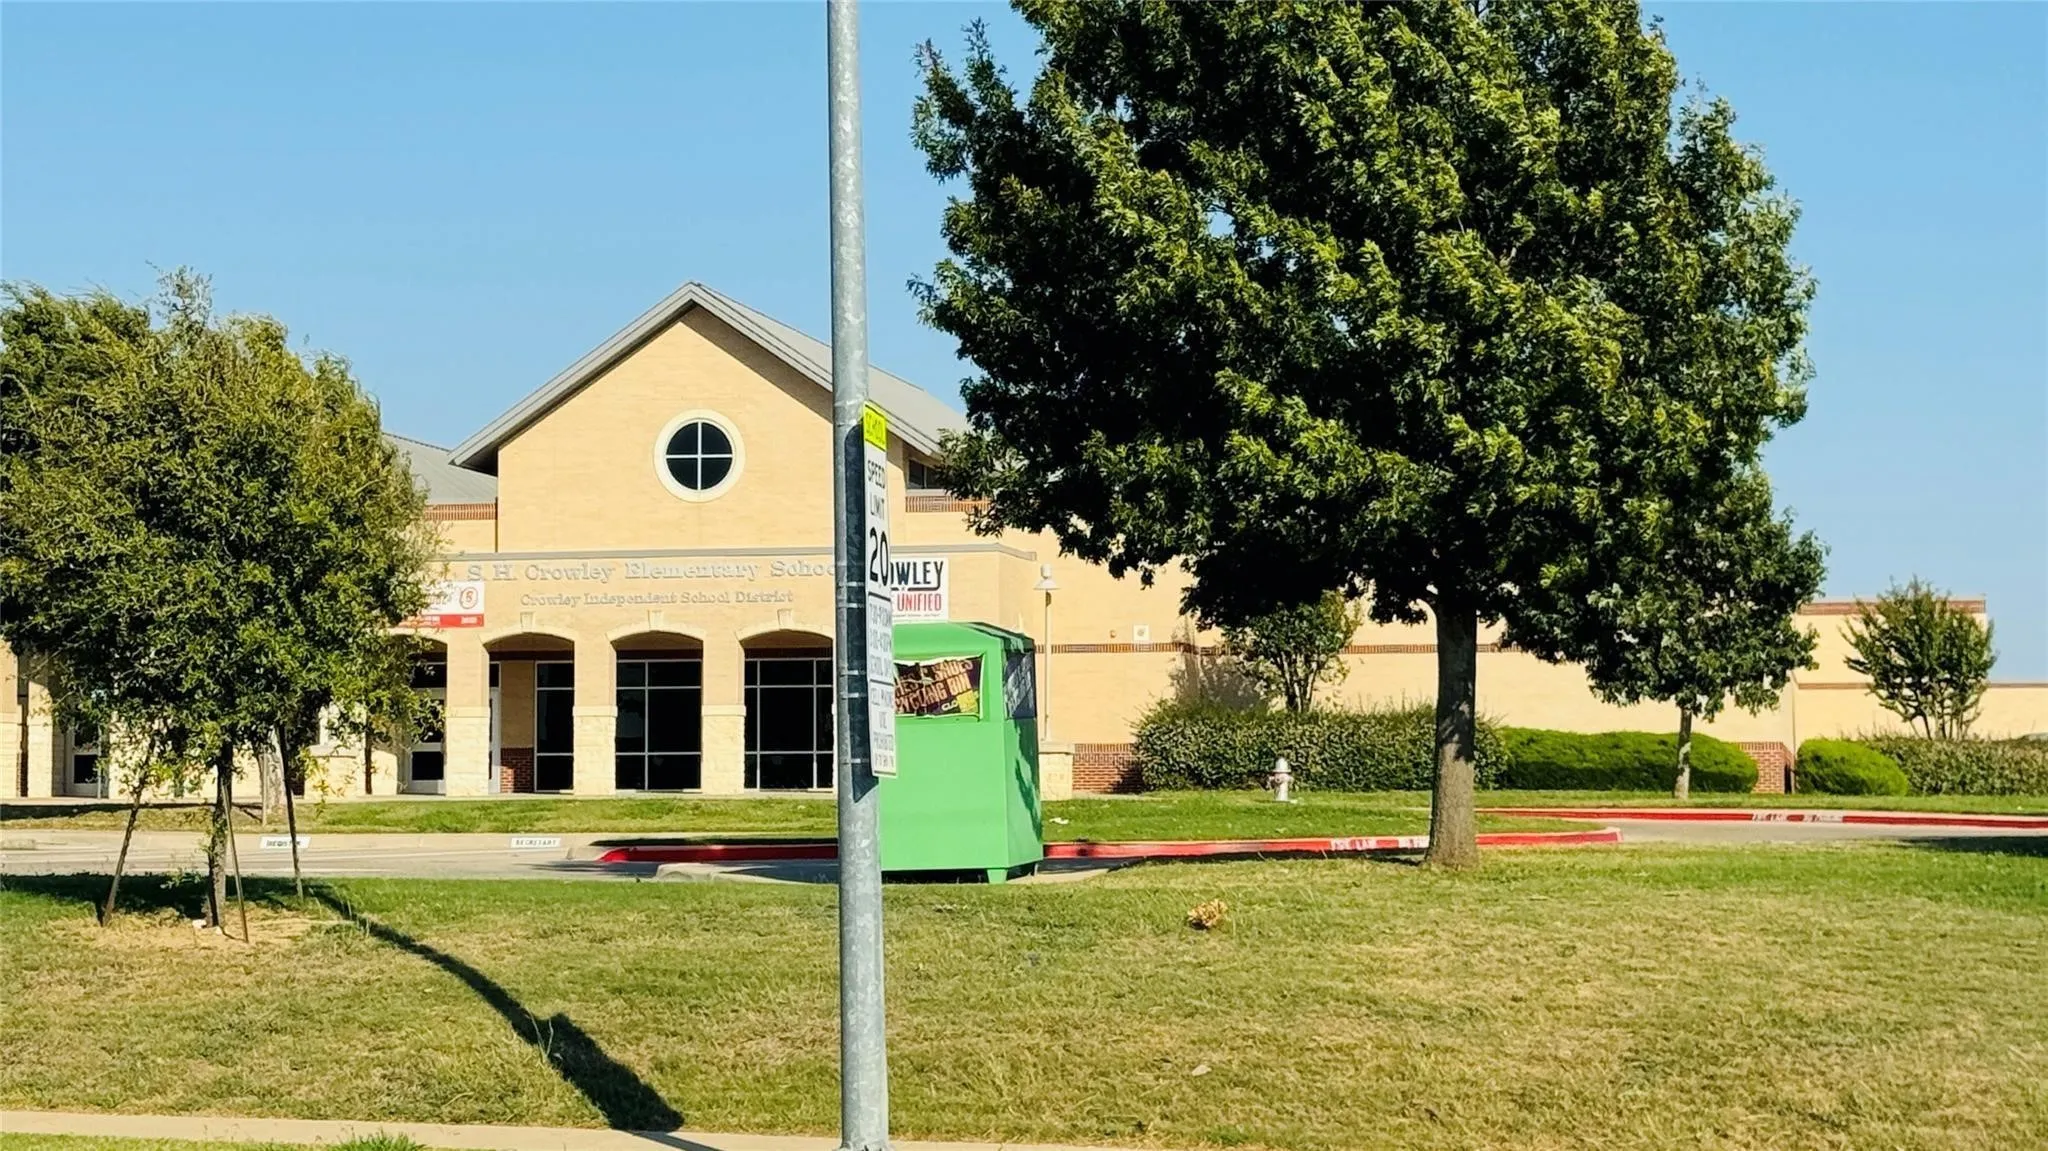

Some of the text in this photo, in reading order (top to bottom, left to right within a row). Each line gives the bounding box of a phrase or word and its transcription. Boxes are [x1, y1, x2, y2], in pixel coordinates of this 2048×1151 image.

[868, 460, 885, 488] SPEED
[870, 527, 888, 586] 20
[525, 562, 616, 583] Crowley
[624, 560, 760, 581] Elementary
[770, 560, 835, 577] Schoo
[520, 590, 794, 607] Crowley Independent School District
[897, 593, 942, 612] UNIFIED
[946, 673, 972, 696] BIN
